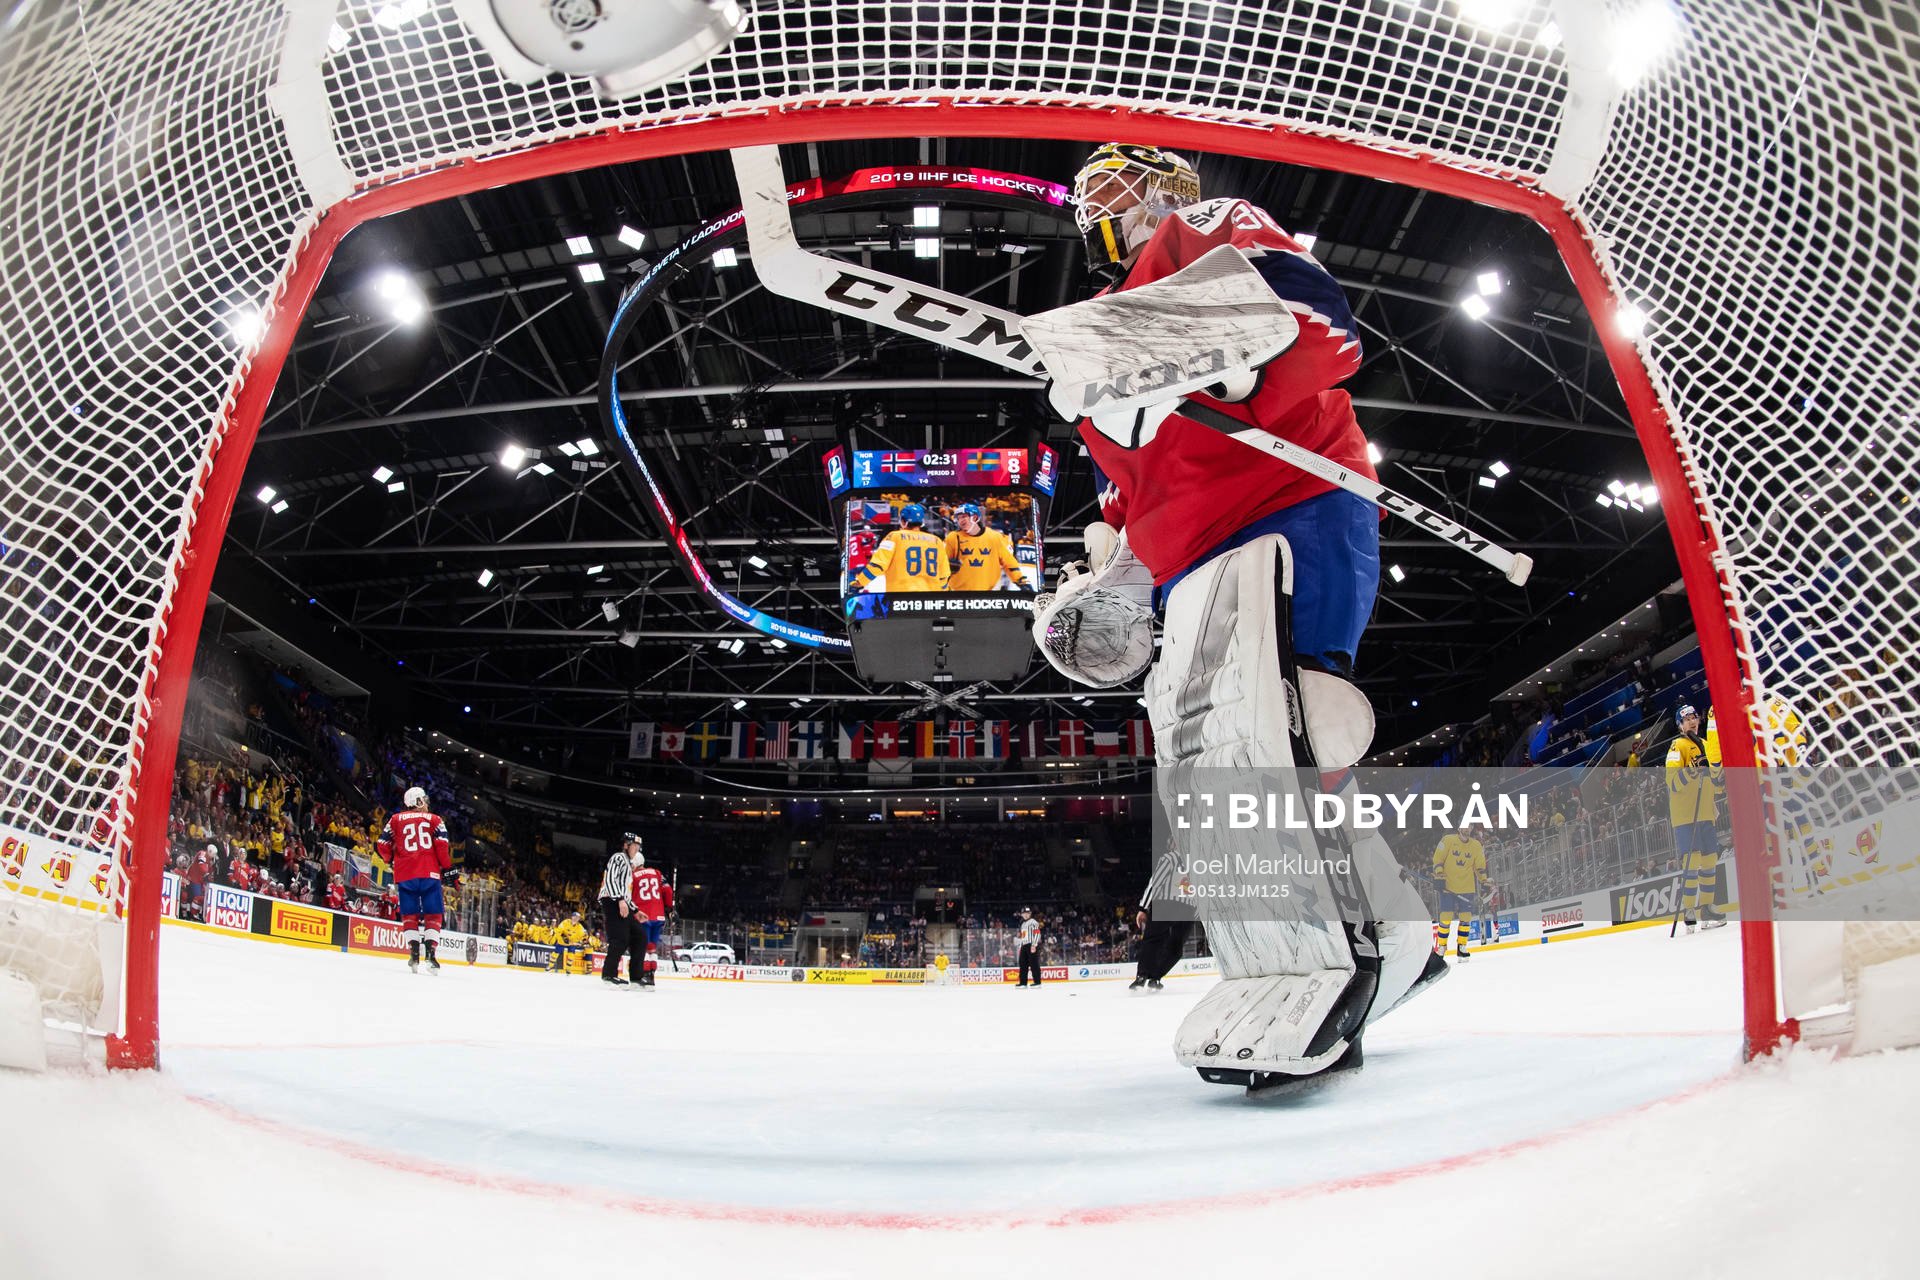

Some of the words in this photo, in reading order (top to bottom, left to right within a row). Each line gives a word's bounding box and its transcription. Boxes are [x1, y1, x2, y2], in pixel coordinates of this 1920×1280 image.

[870, 172, 914, 184] 2019
[918, 172, 949, 183] IIHF
[952, 173, 978, 184] ICE
[981, 174, 1046, 195] HOCKEY
[824, 270, 1048, 375] CCM
[862, 460, 873, 475] 1
[923, 453, 958, 465] 02:31
[1008, 458, 1020, 473] 8
[1273, 441, 1339, 480] PREMIER
[1375, 487, 1491, 554] CCM
[906, 546, 938, 577] 88
[893, 600, 923, 611] 2019
[924, 600, 944, 610] IIHF
[946, 600, 964, 610] ICE
[965, 599, 1009, 610] HOCKEY
[402, 821, 433, 852] 26
[639, 877, 661, 901] 22
[217, 890, 249, 912] LIQUI
[216, 908, 249, 929] MOLY
[277, 909, 328, 937] PIRELLI
[1541, 908, 1584, 927] STRABAG
[439, 937, 465, 949] TISSOT
[512, 946, 537, 966] NIVEA
[691, 965, 744, 980] ФОНБЕТ
[759, 969, 789, 977] TISSOT
